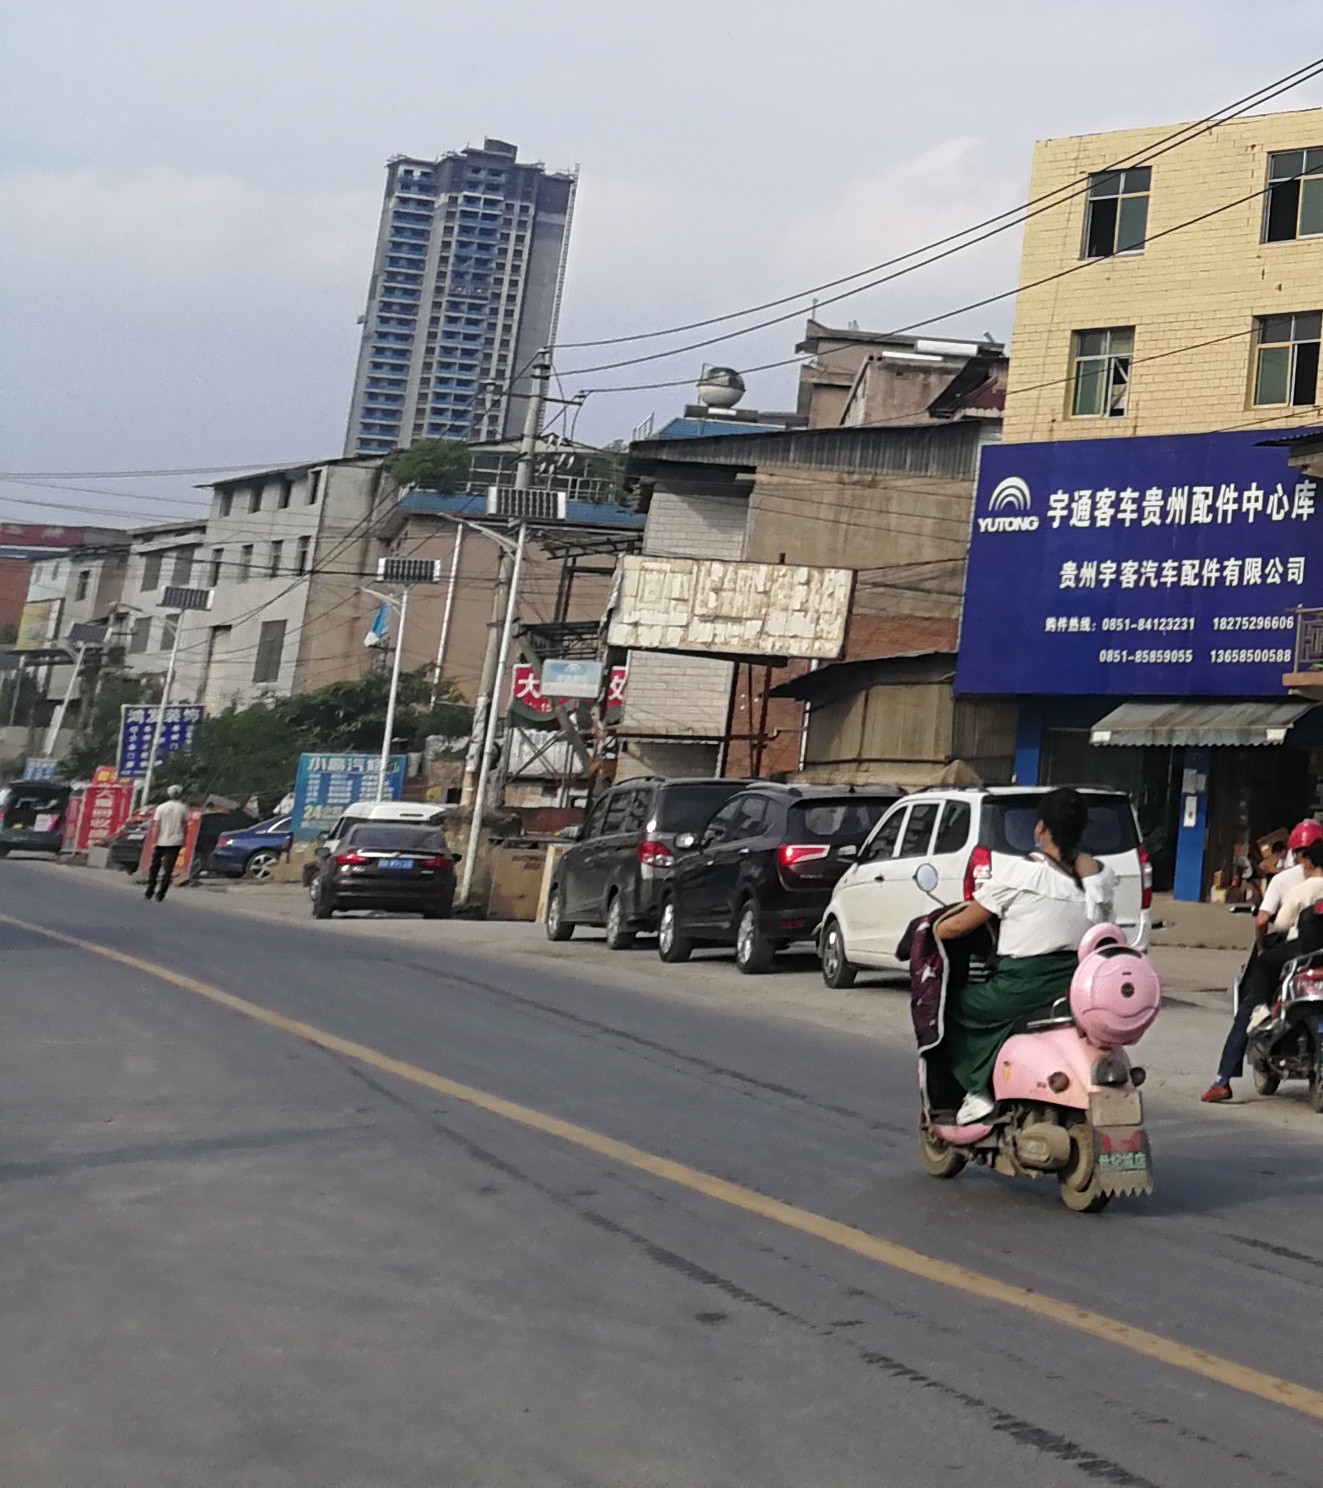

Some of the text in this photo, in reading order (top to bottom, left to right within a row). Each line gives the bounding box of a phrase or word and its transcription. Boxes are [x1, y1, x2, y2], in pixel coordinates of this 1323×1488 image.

[1046, 479, 1318, 529] 宇通客车贵州配件中心库
[977, 516, 1040, 533] YUTONG
[1059, 556, 1307, 589] 贵州宇客汽车配件有限公司
[1212, 615, 1295, 631] 18275296606
[1210, 649, 1292, 663] 13658500588
